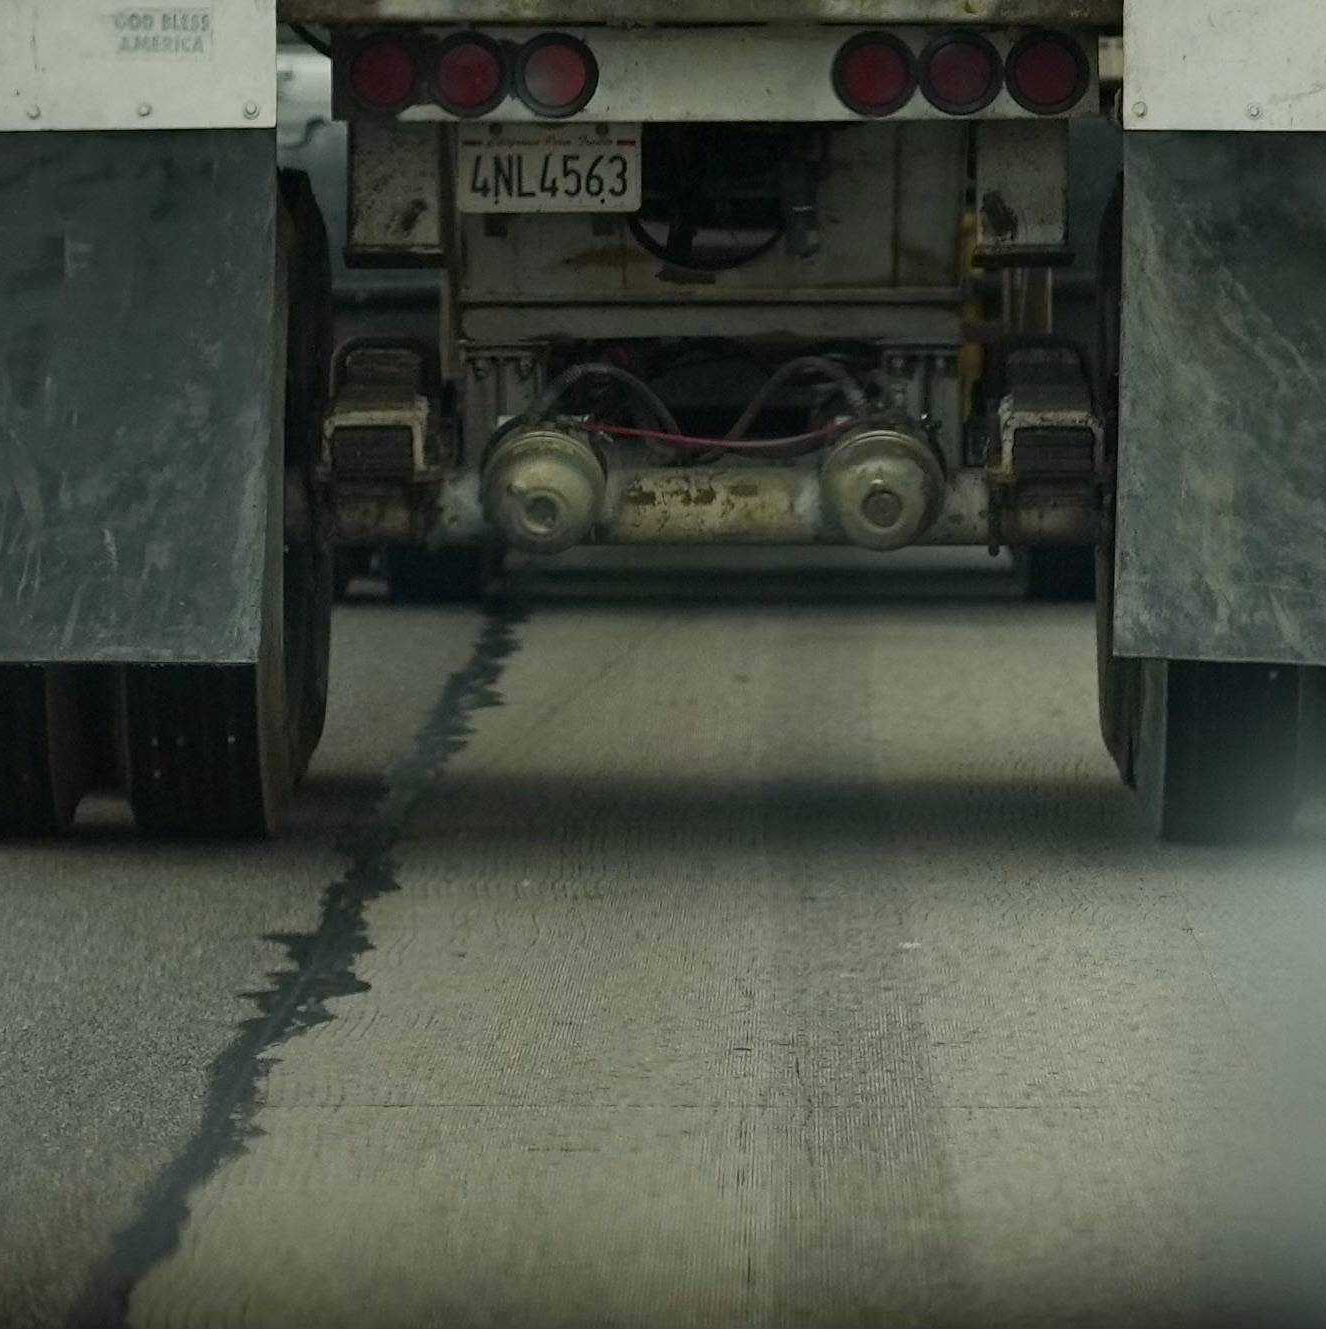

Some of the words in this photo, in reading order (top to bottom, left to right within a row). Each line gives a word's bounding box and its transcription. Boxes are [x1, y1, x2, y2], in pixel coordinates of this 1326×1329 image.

[115, 13, 154, 31] GOD
[162, 13, 211, 31] BLESS
[117, 35, 204, 53] AMERICA
[472, 153, 627, 197] 4NL4563
